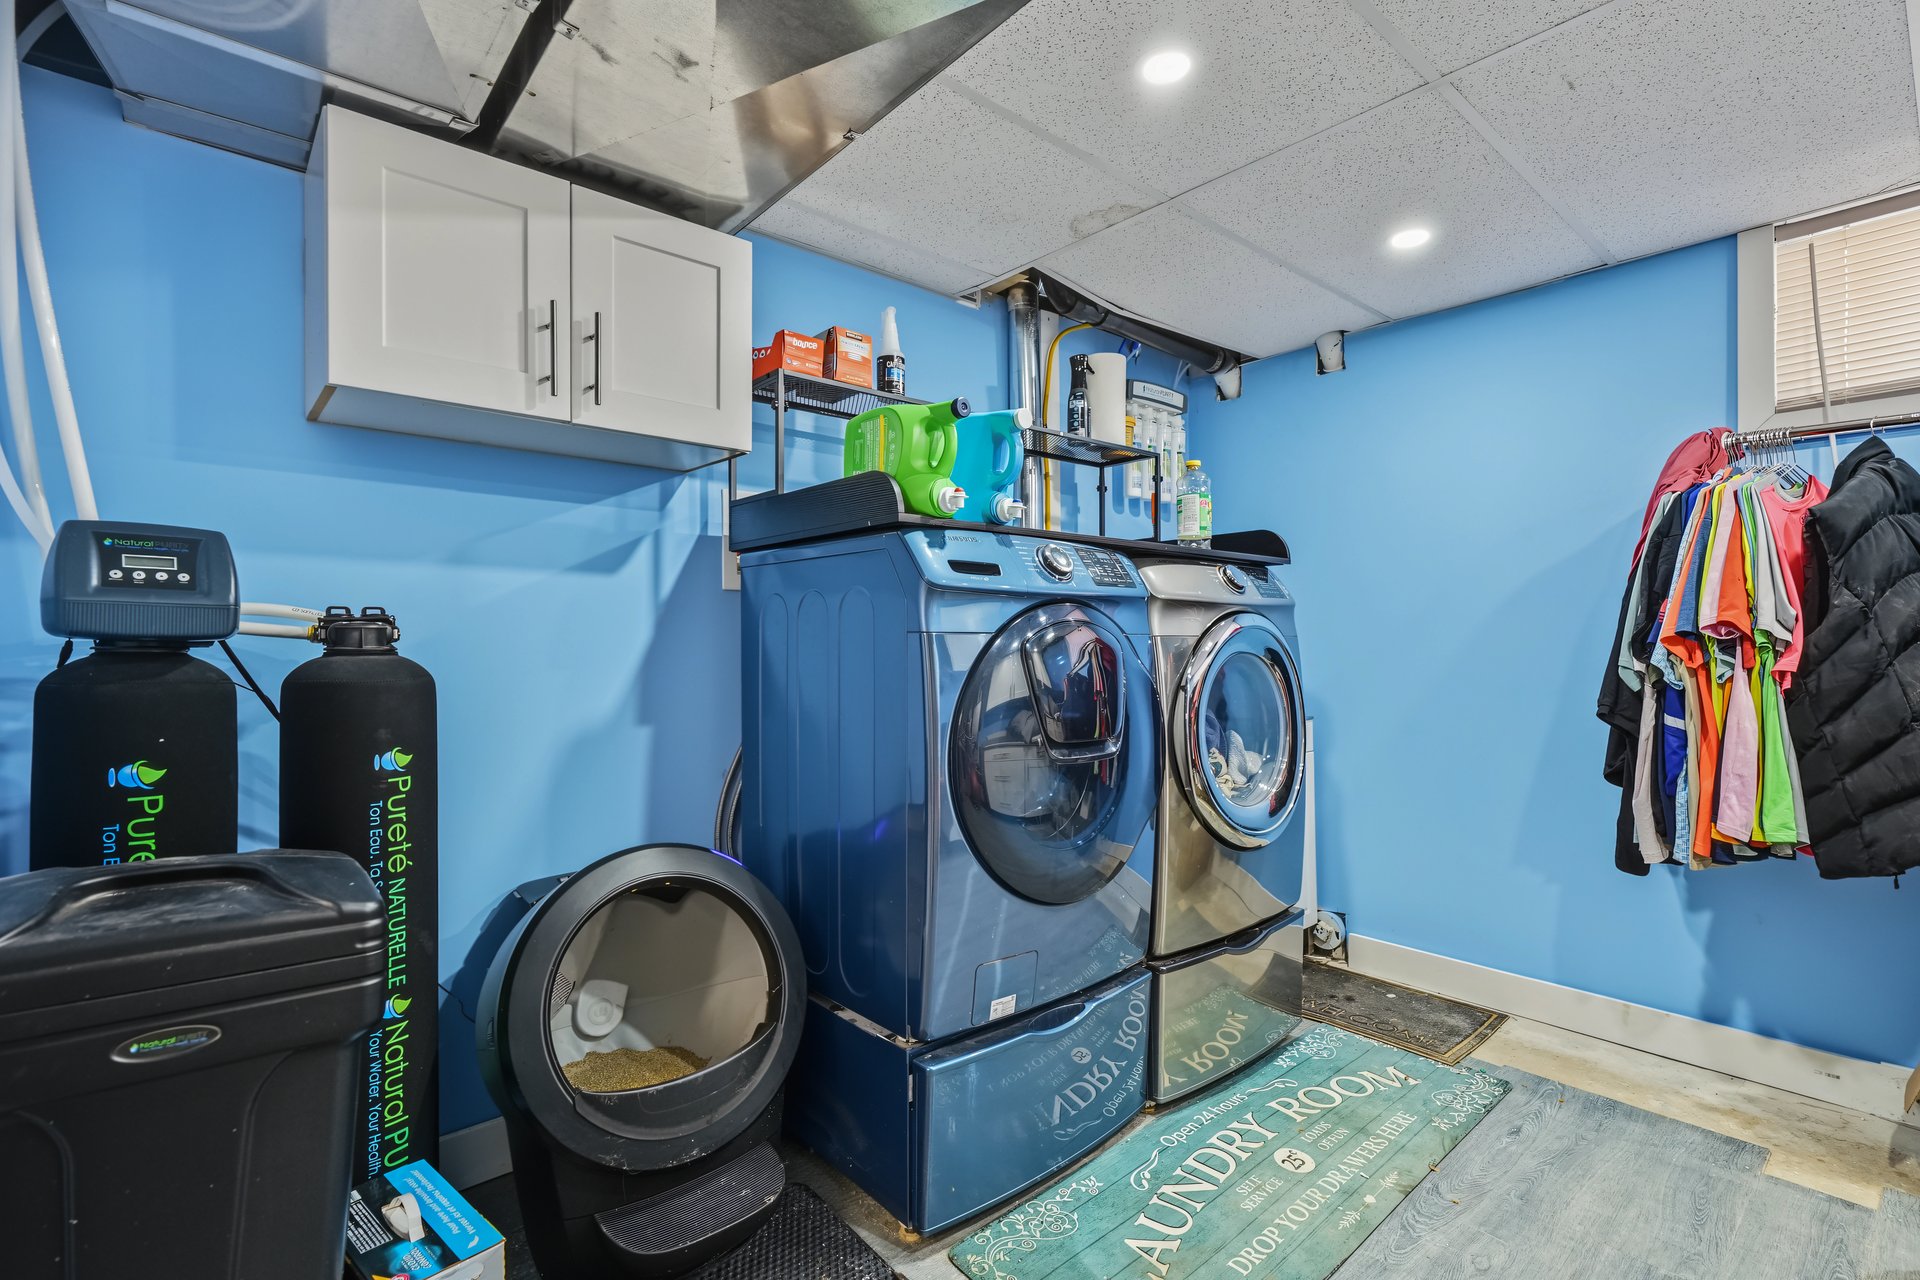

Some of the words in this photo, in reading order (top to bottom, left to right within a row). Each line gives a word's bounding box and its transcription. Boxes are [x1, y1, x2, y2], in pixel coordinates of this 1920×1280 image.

[793, 338, 818, 349] bounce
[114, 538, 154, 547] Natural
[370, 800, 383, 826] Ton
[387, 775, 413, 873] Pureté
[103, 823, 120, 853] Ton
[370, 829, 383, 859] Eau.
[388, 877, 406, 989] NATURELLE
[369, 1029, 383, 1061] Your
[368, 1060, 382, 1102] Water.
[384, 1020, 409, 1127] Natural
[1265, 1066, 1422, 1123] ROOM
[368, 1103, 382, 1131] Your
[1160, 1121, 1202, 1148] Open
[1196, 1111, 1214, 1129] 24
[1211, 1092, 1248, 1119] hours
[1300, 1121, 1332, 1144] LOADS
[1317, 1138, 1334, 1151] OF
[1327, 1127, 1350, 1144] FUN
[368, 1134, 382, 1180] Health.
[1226, 1226, 1285, 1277] DROP
[1273, 1188, 1331, 1231] YOUR
[1318, 1134, 1389, 1194] DRAWERS
[1375, 1110, 1418, 1140] HERE
[1235, 1174, 1263, 1196] SELF
[1240, 1176, 1284, 1212] SERVICE
